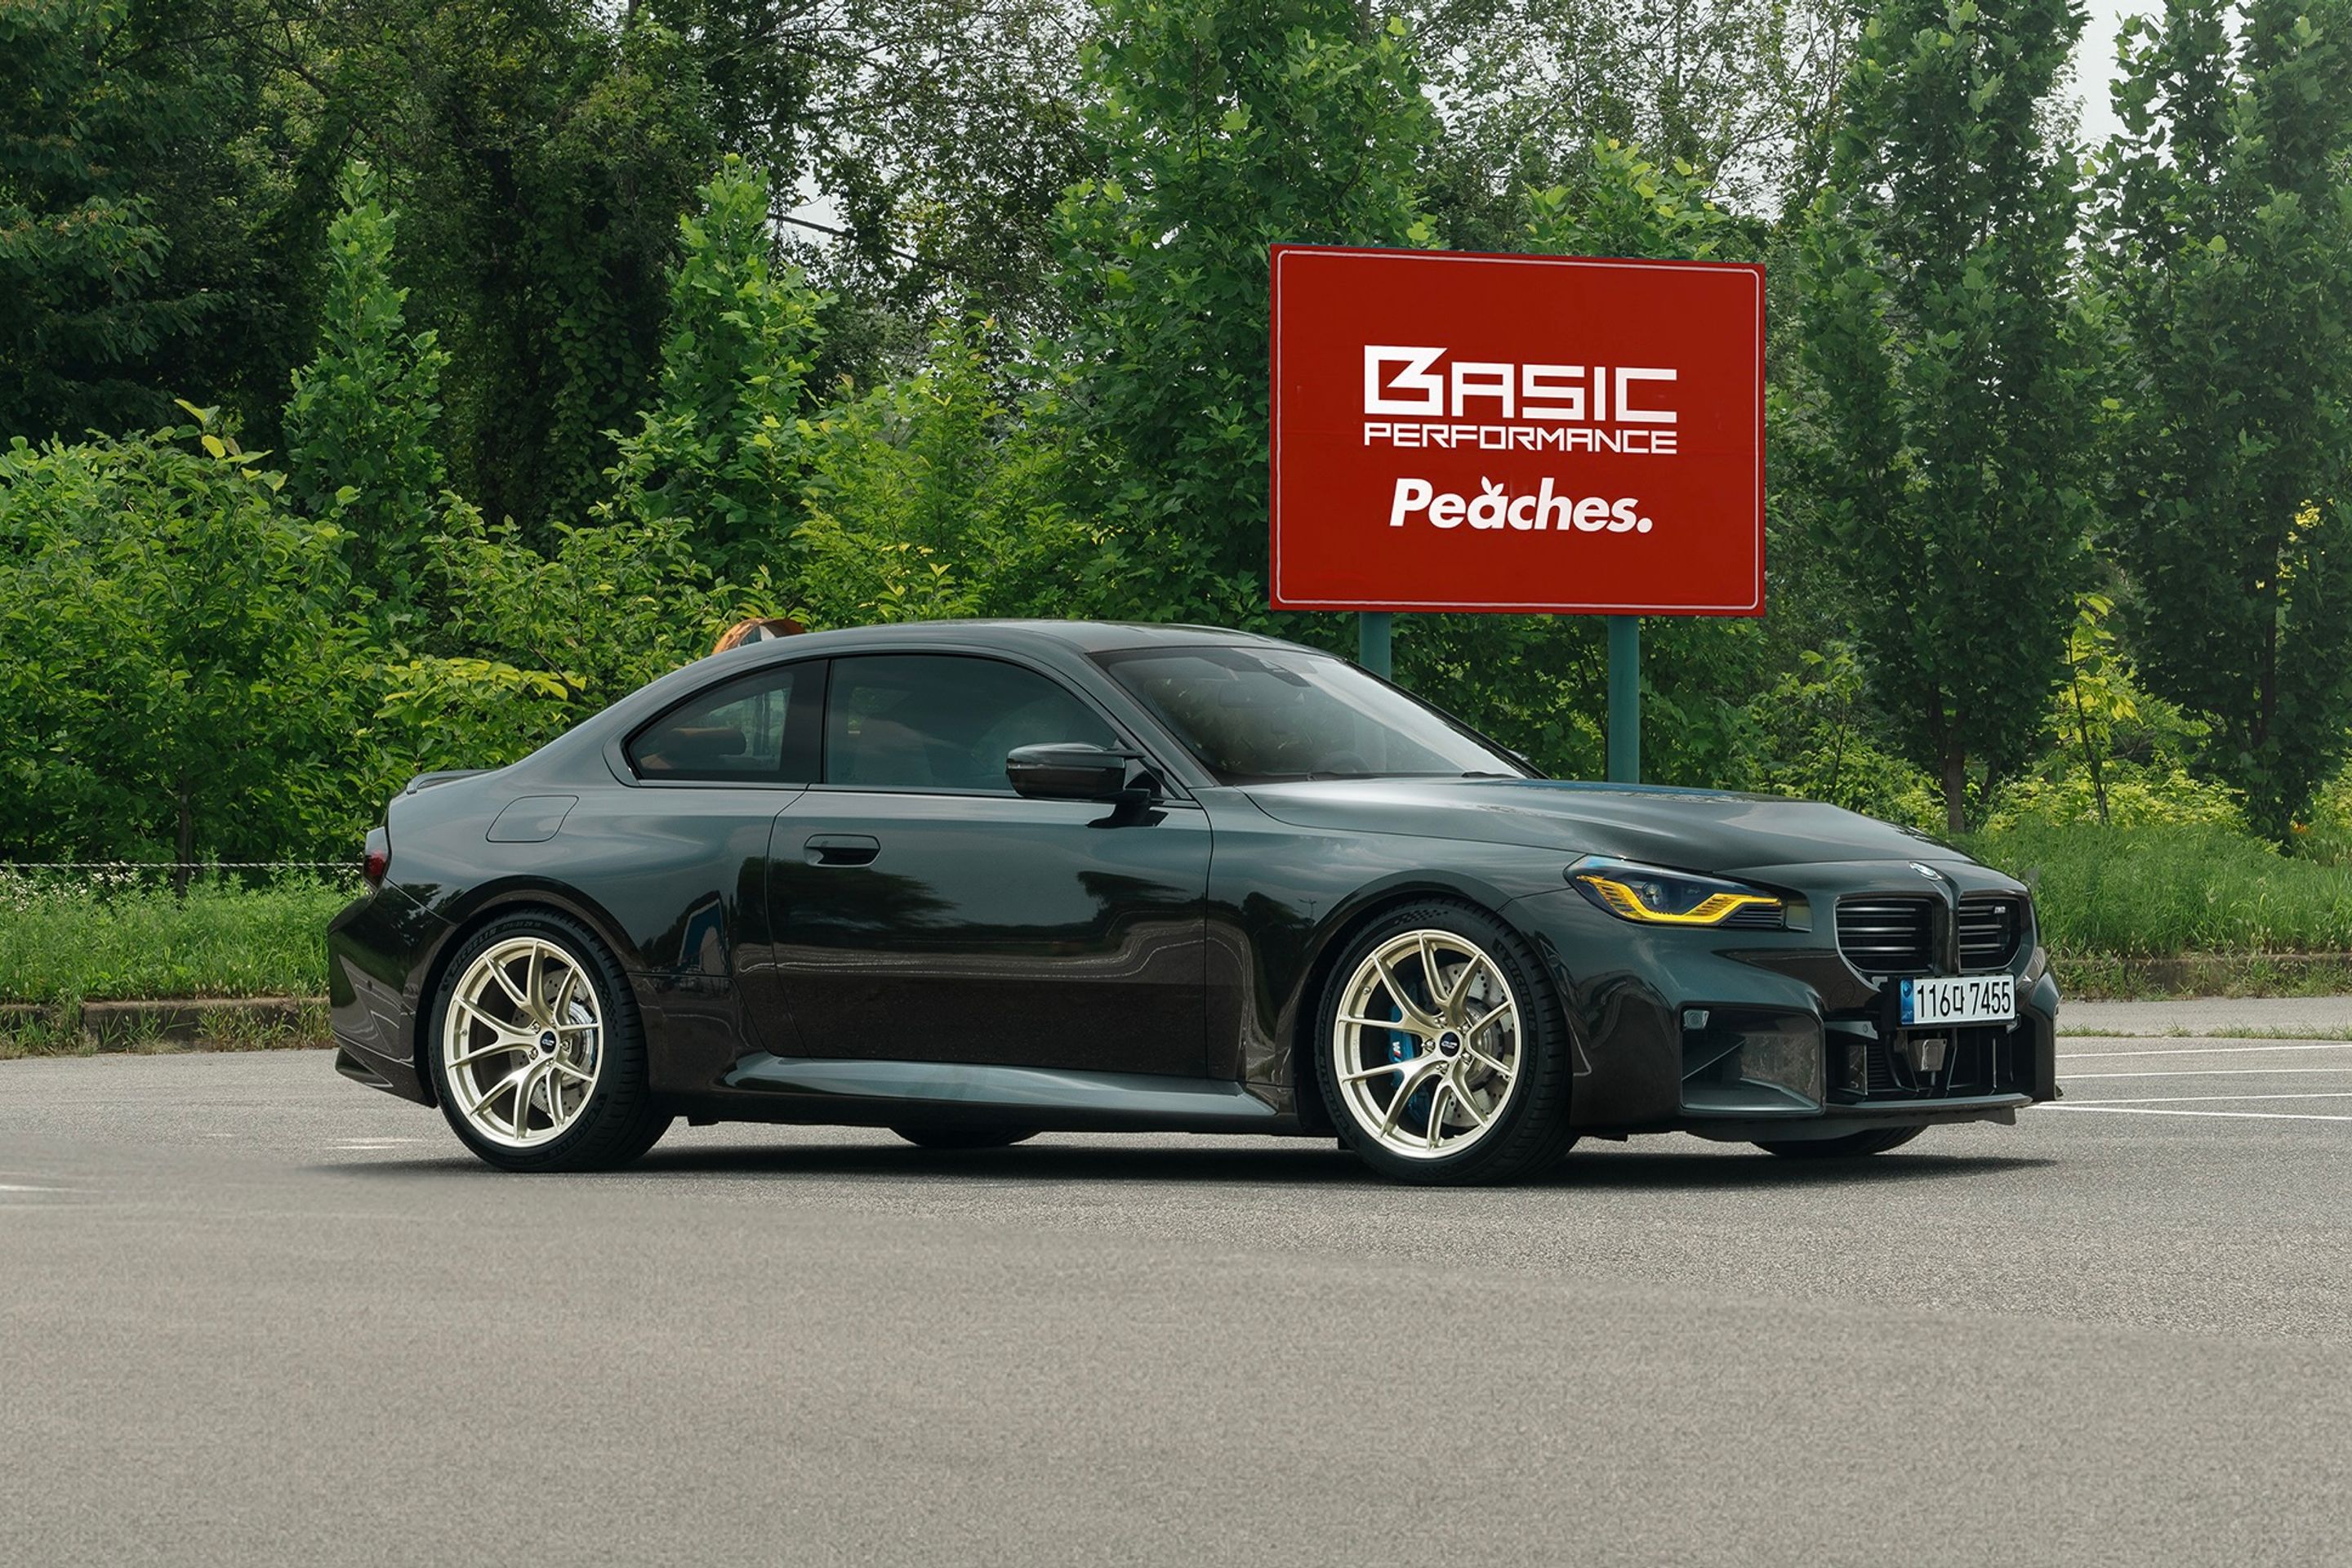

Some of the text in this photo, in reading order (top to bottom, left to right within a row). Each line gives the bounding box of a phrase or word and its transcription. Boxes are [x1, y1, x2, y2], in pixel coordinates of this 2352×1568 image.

[1365, 345, 1677, 424] BASIC
[1365, 421, 1677, 455] PERFORMANCE
[1390, 475, 1653, 533] Peaches.
[1917, 981, 2011, 1018] 116다 7455
